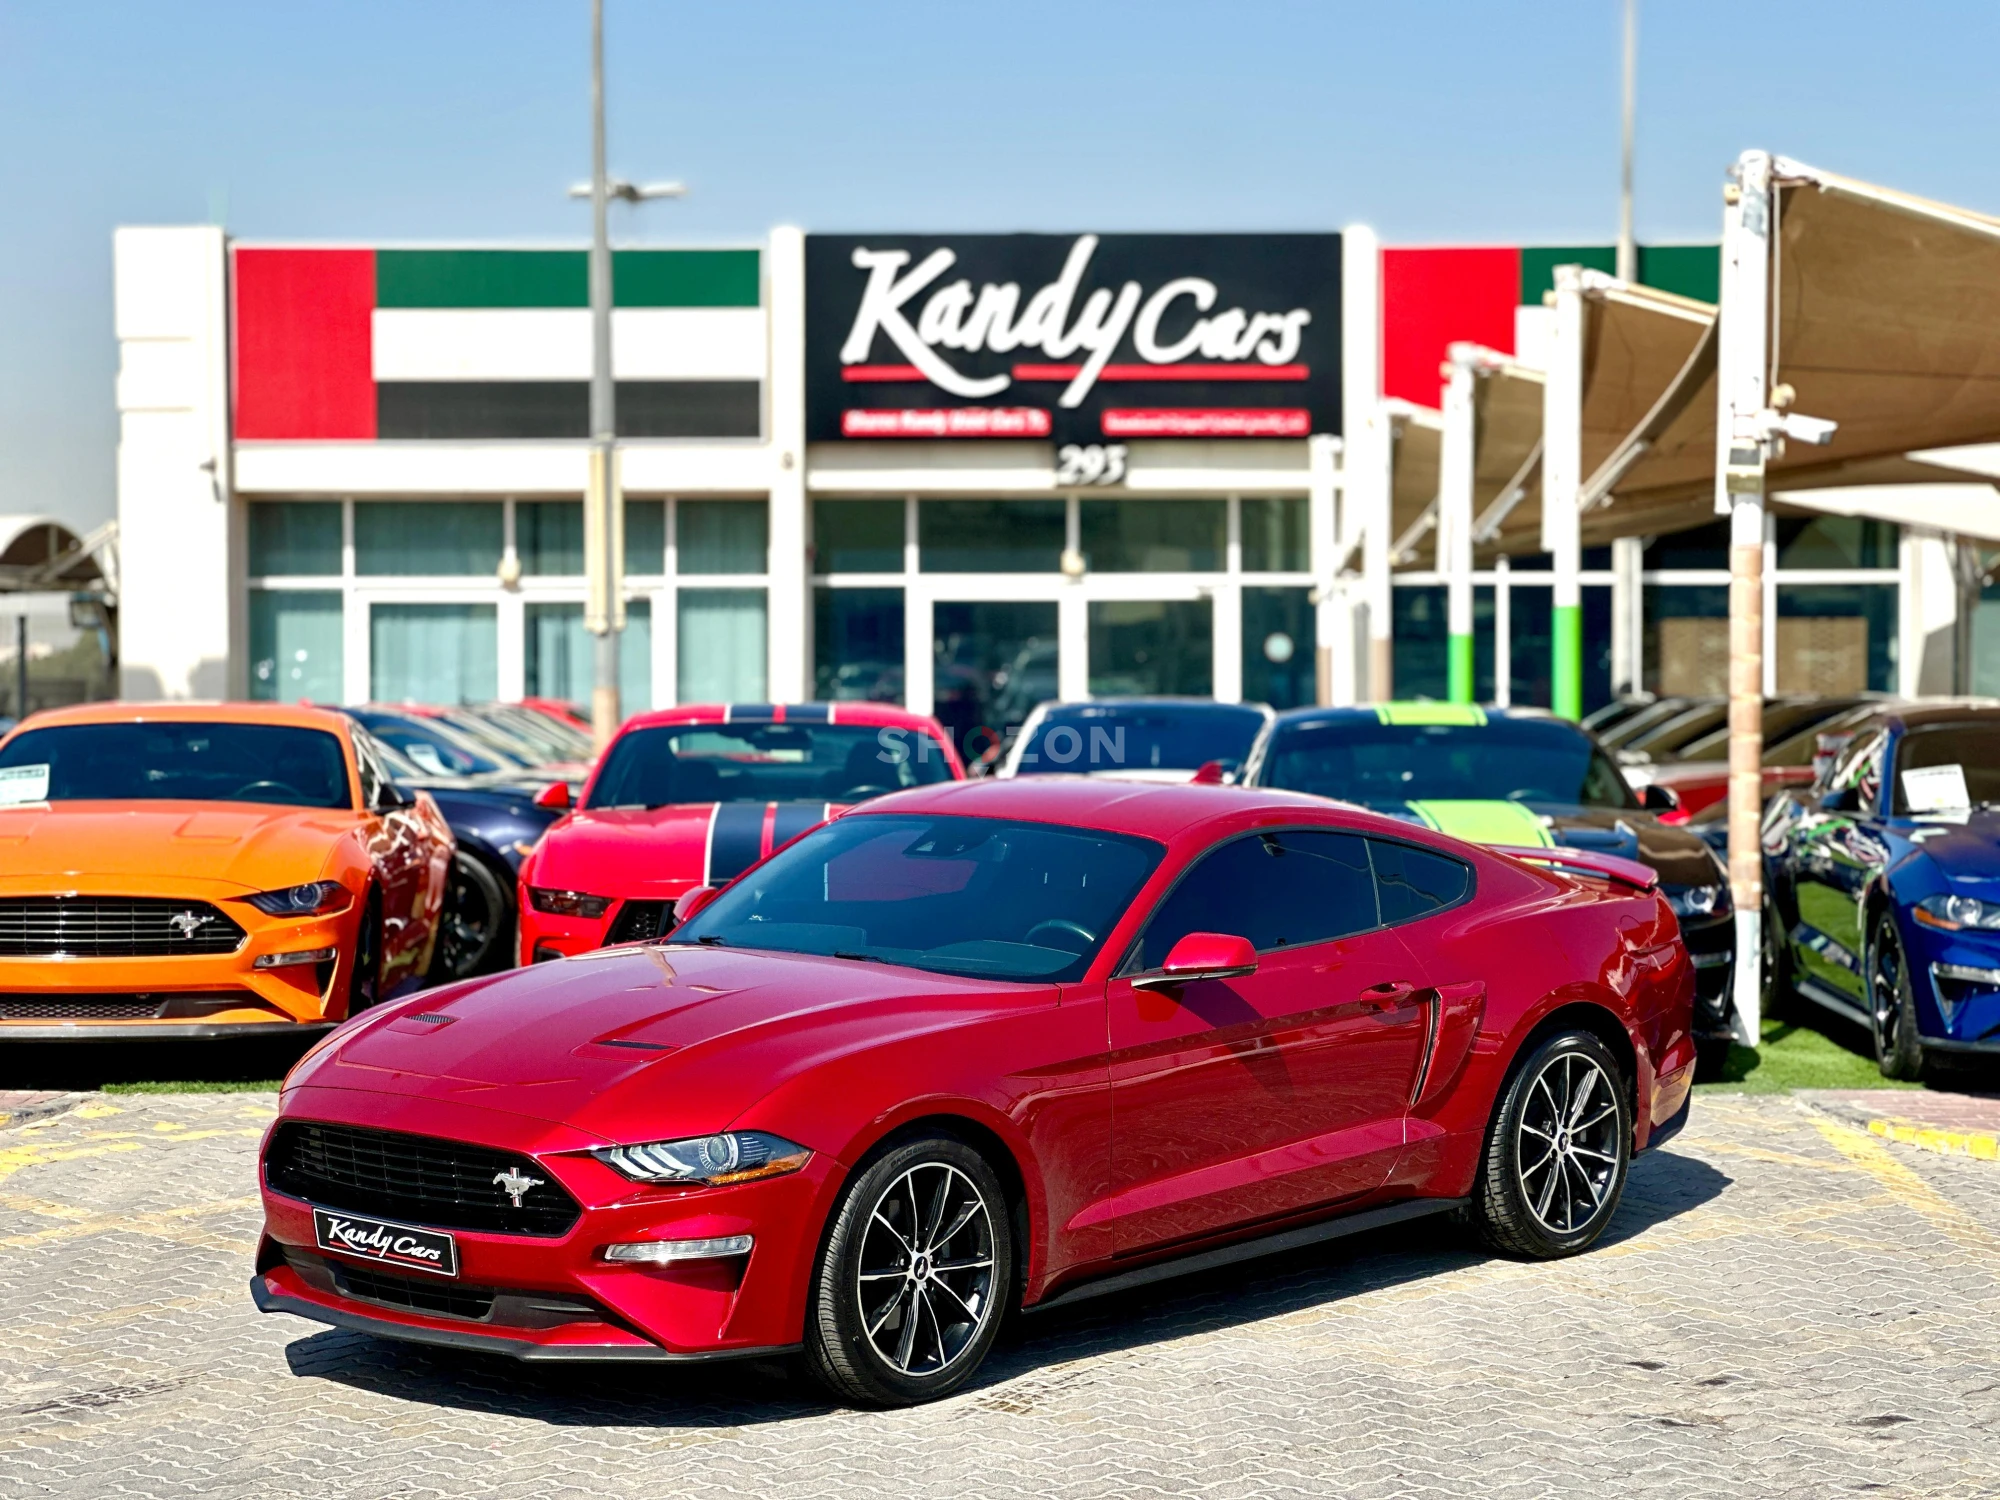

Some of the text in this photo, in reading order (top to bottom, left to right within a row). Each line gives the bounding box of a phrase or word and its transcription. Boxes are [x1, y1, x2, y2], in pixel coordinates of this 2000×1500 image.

[839, 234, 1311, 408] Kandy Cars
[327, 1217, 441, 1260] Kandy Cars
